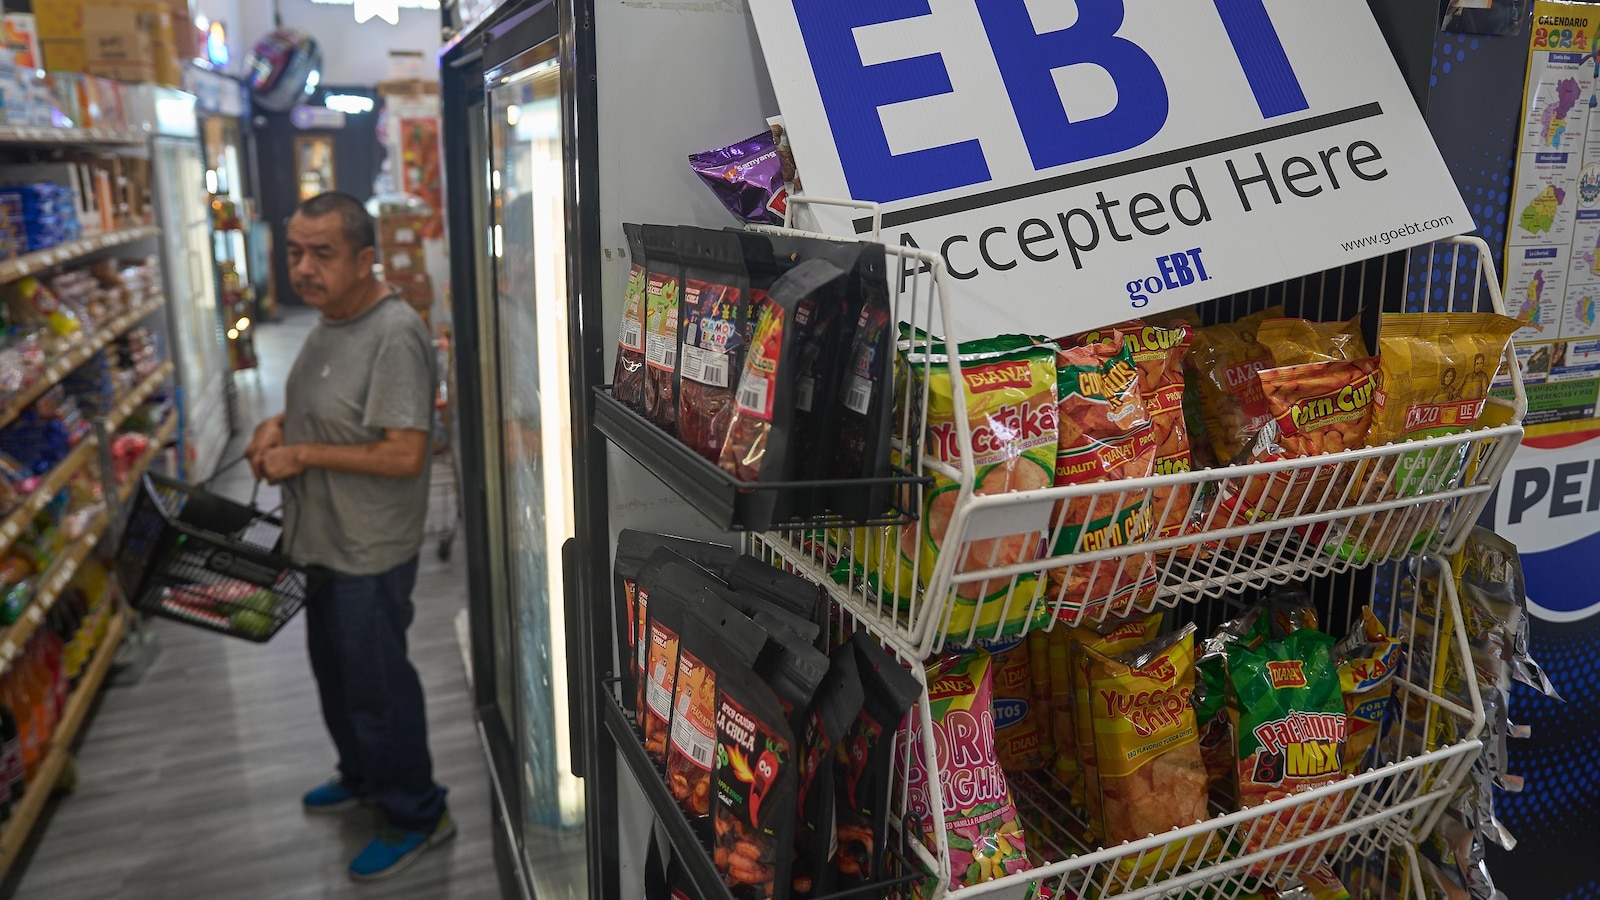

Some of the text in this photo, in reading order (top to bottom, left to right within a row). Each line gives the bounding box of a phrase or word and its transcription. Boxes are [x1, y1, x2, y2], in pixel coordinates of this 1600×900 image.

[1538, 16, 1588, 27] CALENDARIO
[1533, 27, 1587, 50] 2024
[793, 0, 1310, 203] EBT
[898, 138, 1389, 294] Accepted Here
[1341, 215, 1454, 252] www.goebt.com
[966, 366, 1030, 388] DIANA
[1225, 361, 1264, 387] CAZO
[1405, 406, 1440, 429] CAZO
[1460, 404, 1474, 416] DE
[1056, 460, 1097, 477] QUALITY
[1103, 444, 1132, 463] DIANA
[1154, 457, 1190, 475] itos
[1273, 668, 1301, 682] DIANA
[722, 702, 756, 732] SPICY CANDY
[716, 711, 756, 752] LA CHULA
[1179, 728, 1194, 739] CHIPS
[1256, 711, 1347, 755] Pachanga
